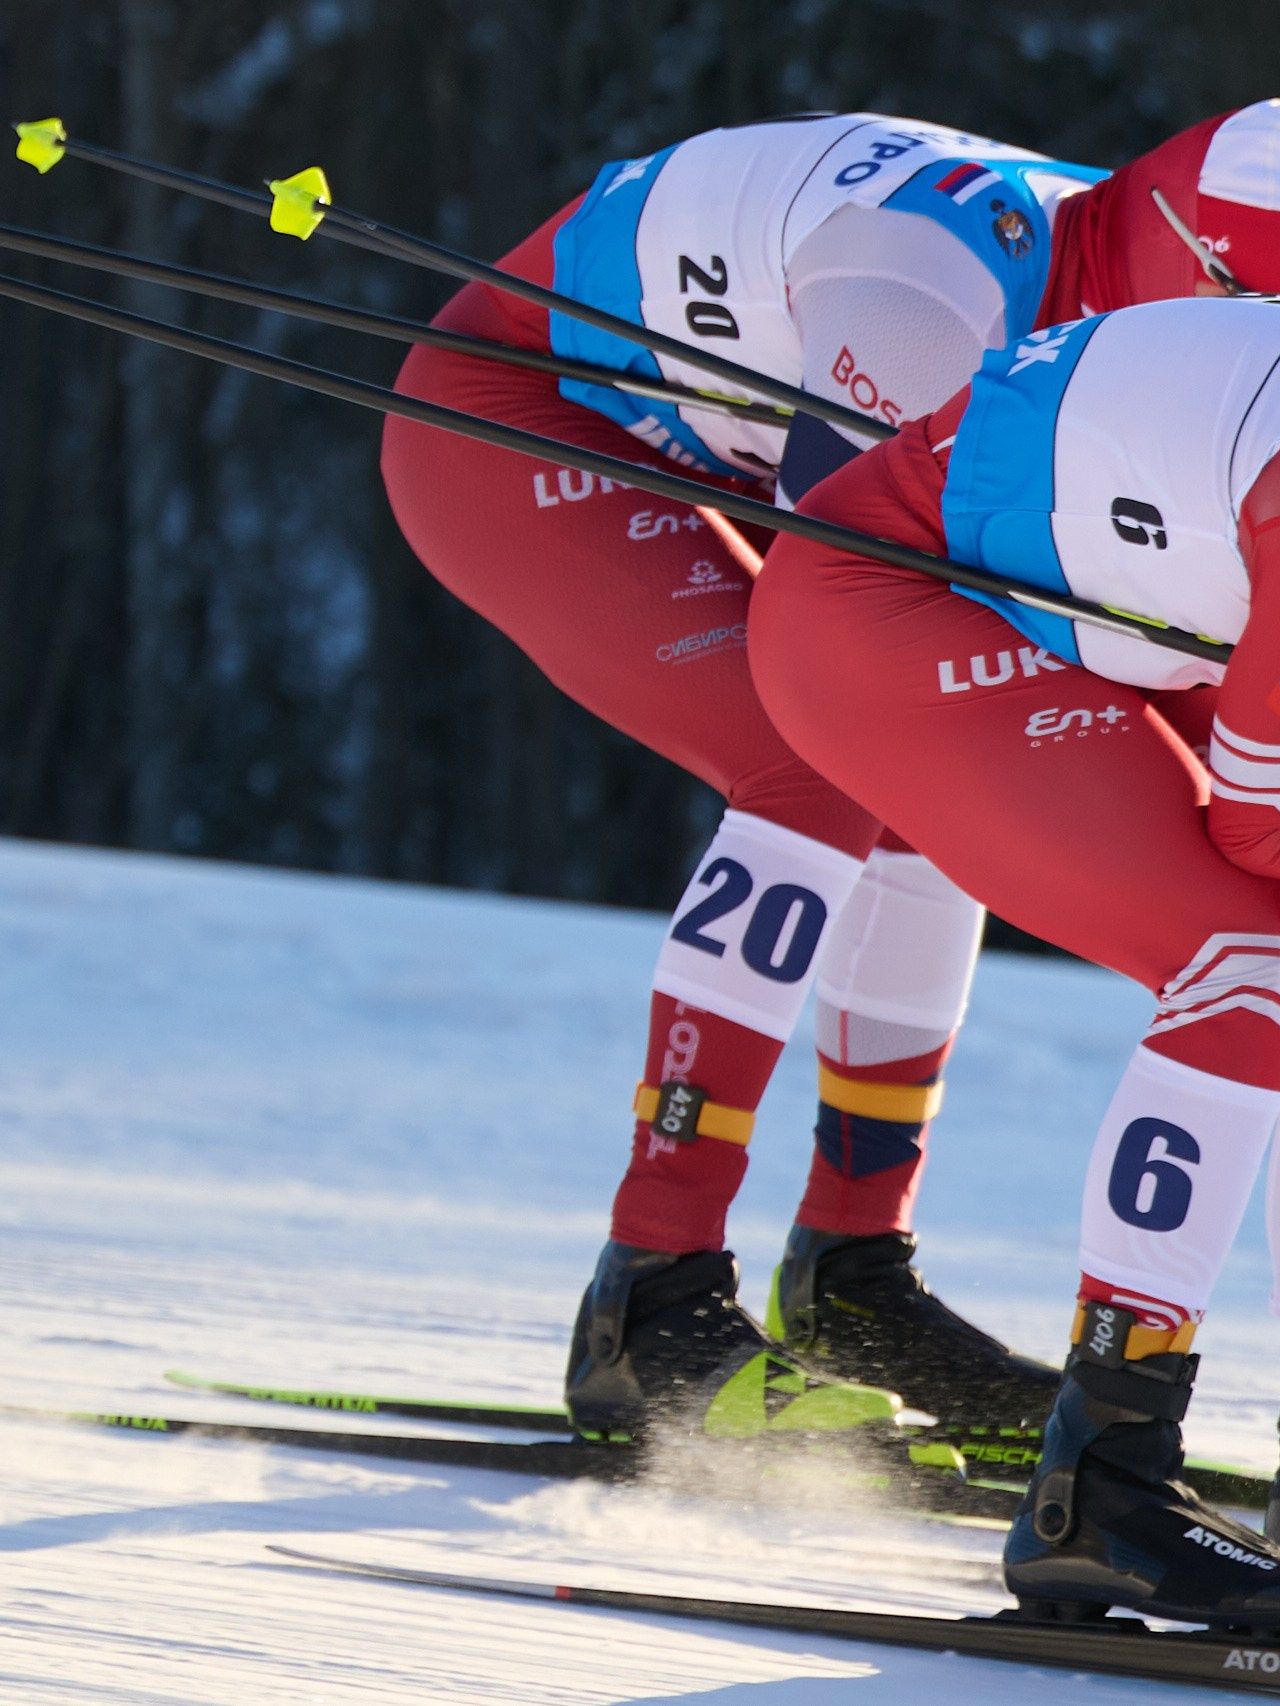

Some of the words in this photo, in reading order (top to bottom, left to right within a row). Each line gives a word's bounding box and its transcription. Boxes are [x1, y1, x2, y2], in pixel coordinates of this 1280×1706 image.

[678, 255, 741, 339] 20
[1110, 496, 1168, 550] 6
[670, 856, 828, 985] 20
[660, 1085, 693, 1133] 420
[1107, 1116, 1201, 1233] 6
[1088, 1308, 1116, 1357] 406
[1182, 1525, 1279, 1571] ATOMIC
